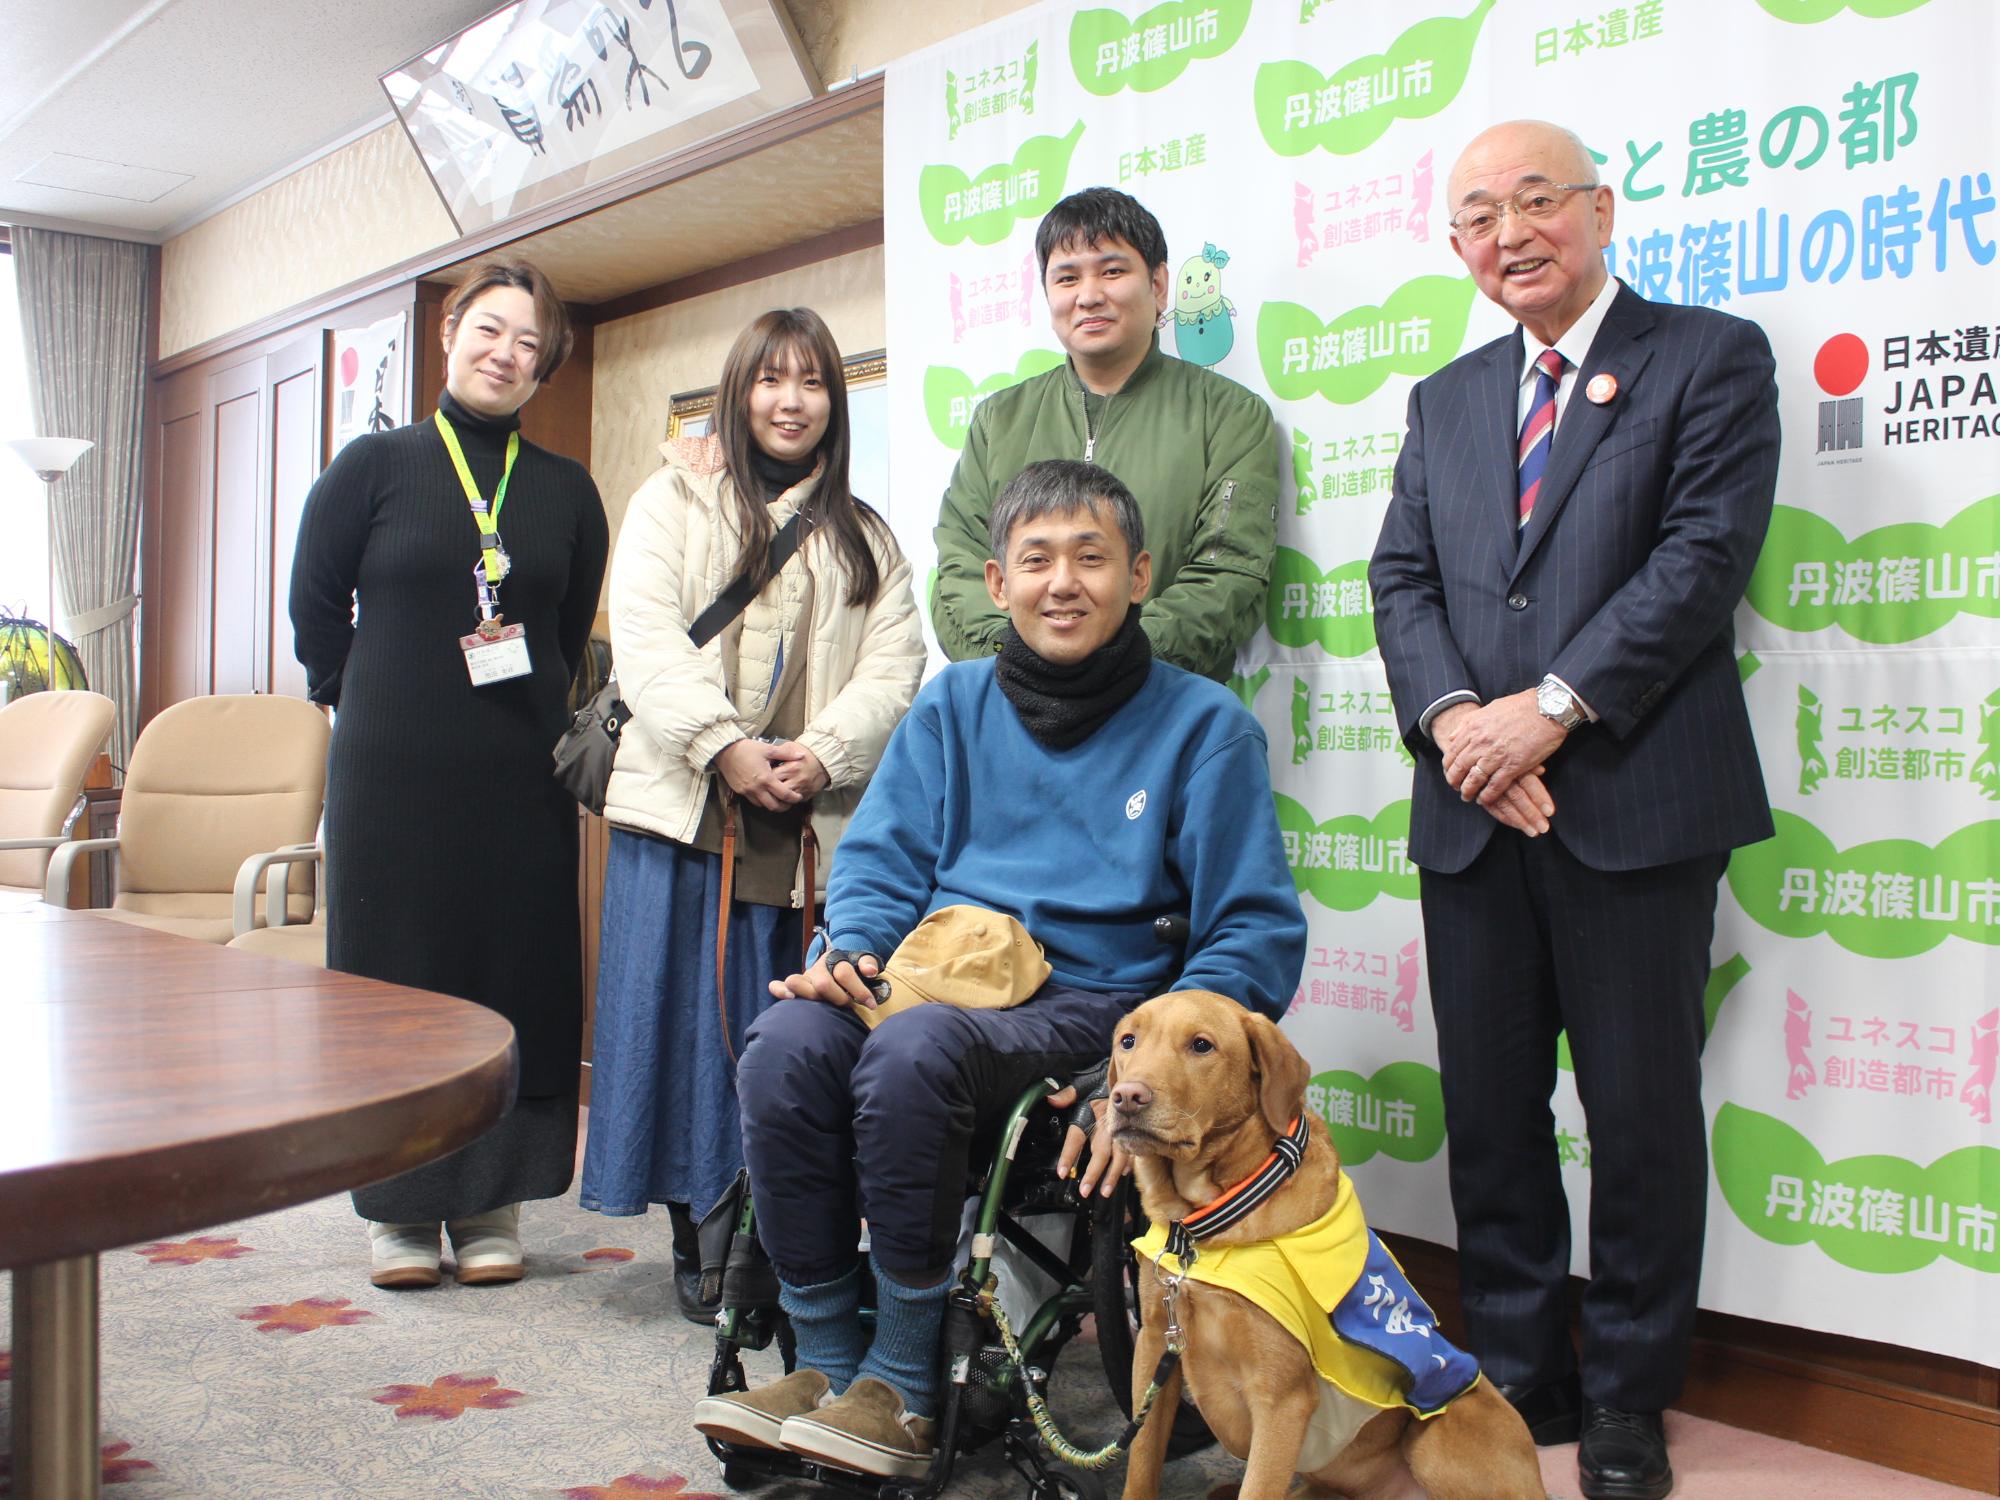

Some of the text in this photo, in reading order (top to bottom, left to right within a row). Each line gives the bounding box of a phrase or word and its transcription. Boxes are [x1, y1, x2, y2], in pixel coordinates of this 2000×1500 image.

[1096, 7, 1217, 77] 丹波篠山市
[1535, 0, 1664, 67] 日本遺産
[964, 60, 1018, 93] ユネスコ
[1284, 59, 1433, 132] 丹波篠山市
[963, 88, 1018, 124] 創造都市
[1587, 72, 1919, 202] と農の都
[1119, 133, 1207, 184] 日本遺産
[944, 169, 1040, 224] 丹波篠山市
[1323, 173, 1403, 214] ユネスコ
[1323, 206, 1403, 250] 創造都市
[968, 270, 1017, 298] ユネスコ
[1283, 316, 1432, 375] 丹波篠山市
[1884, 325, 2000, 371] 日本遺
[1322, 432, 1399, 462] ユネスコ
[1282, 579, 1376, 619] 丹波篠
[1317, 691, 1393, 715] ユネスコ
[1837, 703, 1964, 735] ユネスコ
[1317, 724, 1394, 753] 創造都市
[1835, 746, 1966, 782] 創造都市
[1779, 867, 2000, 926] 丹波篠山市
[1311, 946, 1388, 978] ユネスコ
[1310, 978, 1389, 1015] 創造都市
[1825, 1015, 1957, 1055] ユネスコ
[1823, 1055, 1957, 1100] 創造都市
[1765, 1173, 1996, 1254] 丹波篠山市
